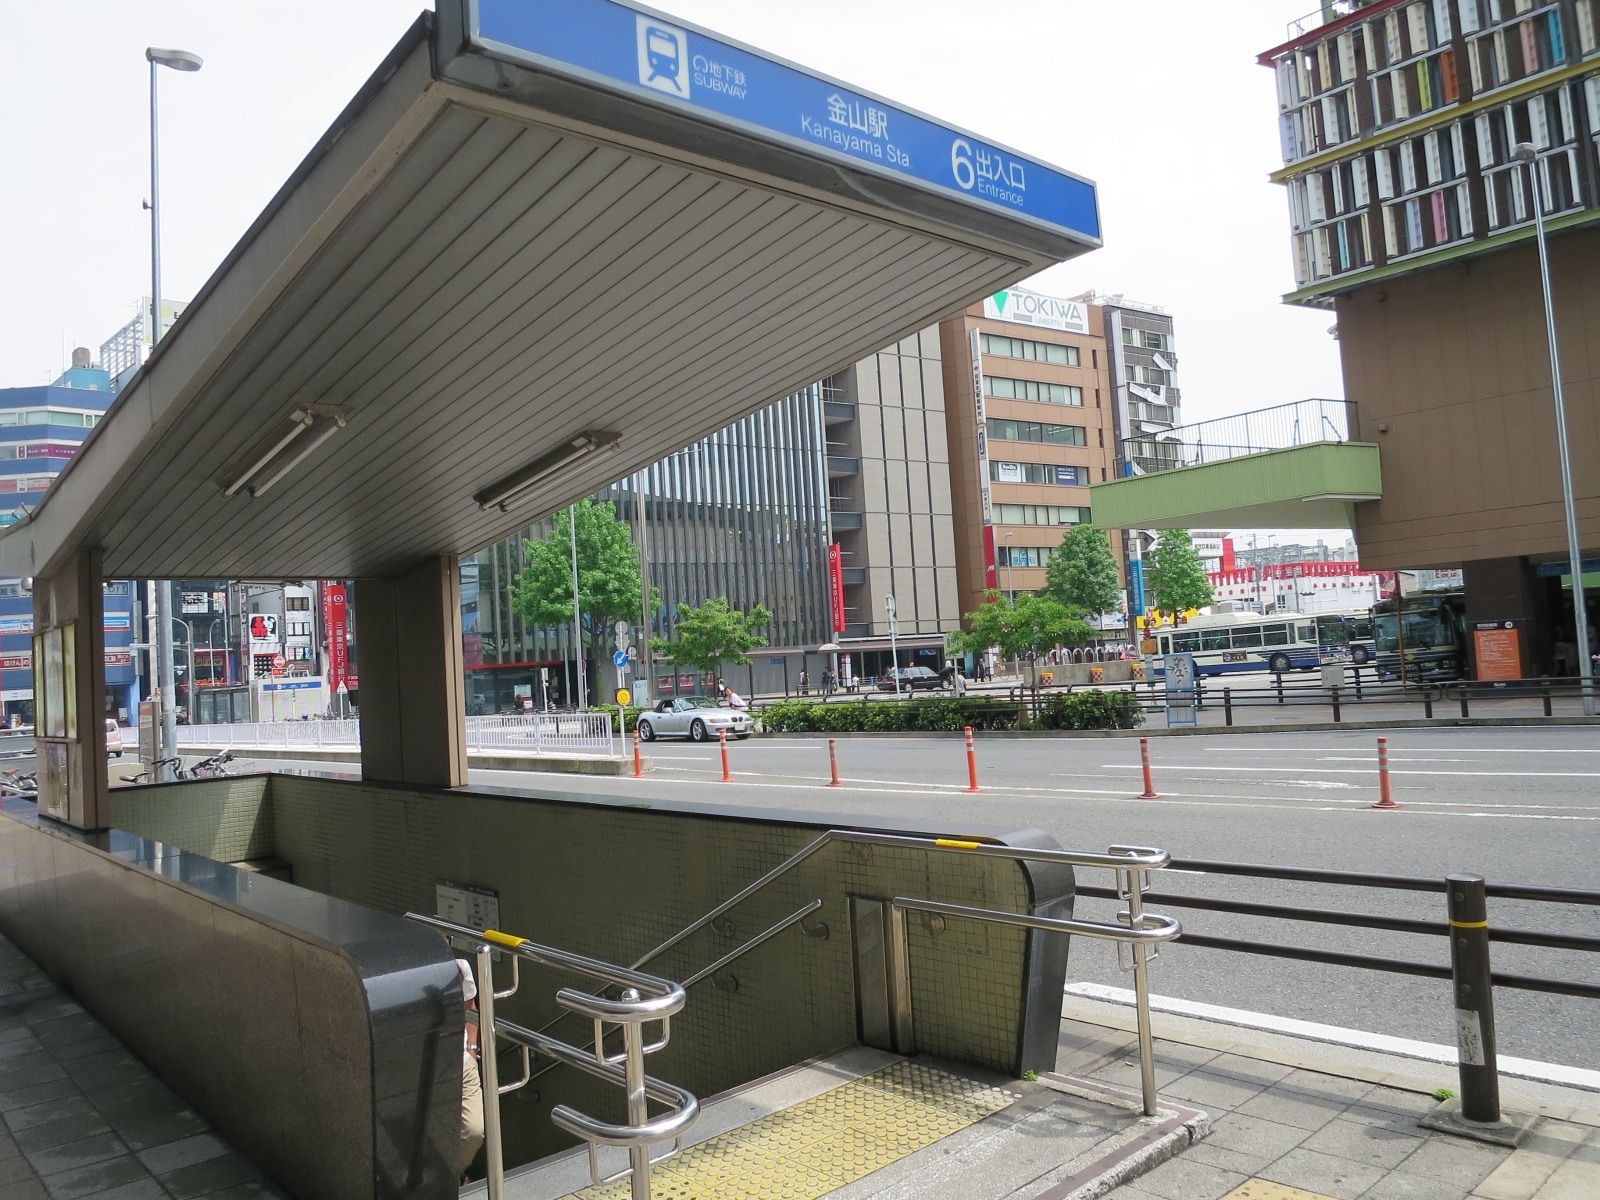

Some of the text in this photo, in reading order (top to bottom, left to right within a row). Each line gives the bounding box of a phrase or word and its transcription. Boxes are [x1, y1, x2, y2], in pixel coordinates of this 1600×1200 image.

[693, 71, 748, 101] SUBWAY
[800, 114, 883, 160] Kanayama
[827, 93, 888, 141] 金山駅
[950, 137, 976, 191] 6
[975, 149, 1026, 193] 出入口
[977, 178, 1024, 207] Entrance
[1011, 293, 1083, 321] TOKIWA
